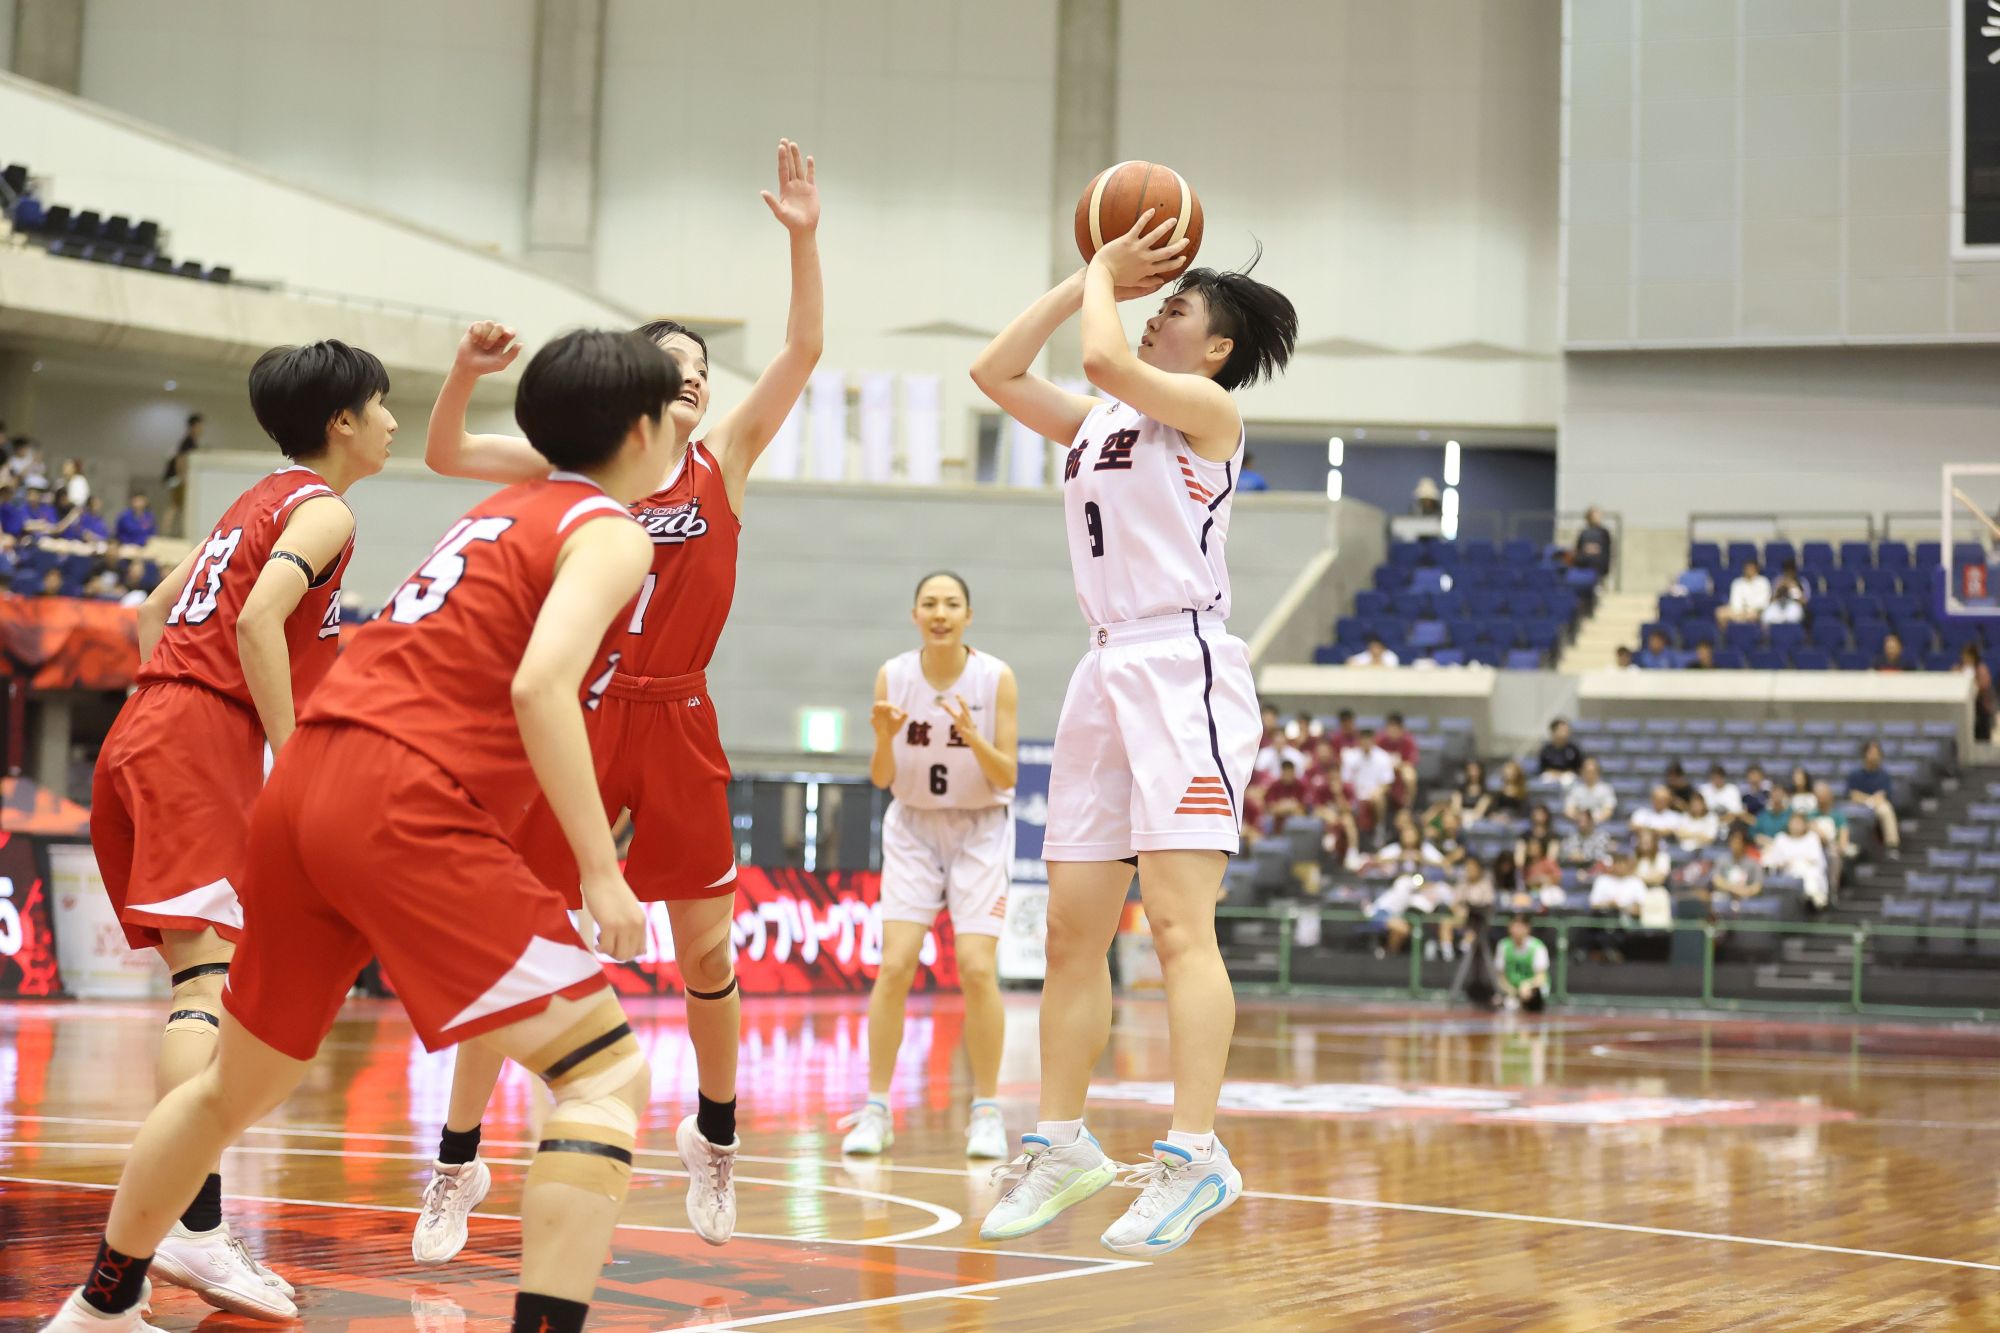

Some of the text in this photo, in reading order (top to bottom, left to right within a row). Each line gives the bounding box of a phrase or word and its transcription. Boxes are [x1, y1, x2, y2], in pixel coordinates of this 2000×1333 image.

[1064, 428, 1141, 483] 航空
[1084, 500, 1105, 558] 9
[167, 527, 243, 626] 13
[929, 764, 948, 796] 6
